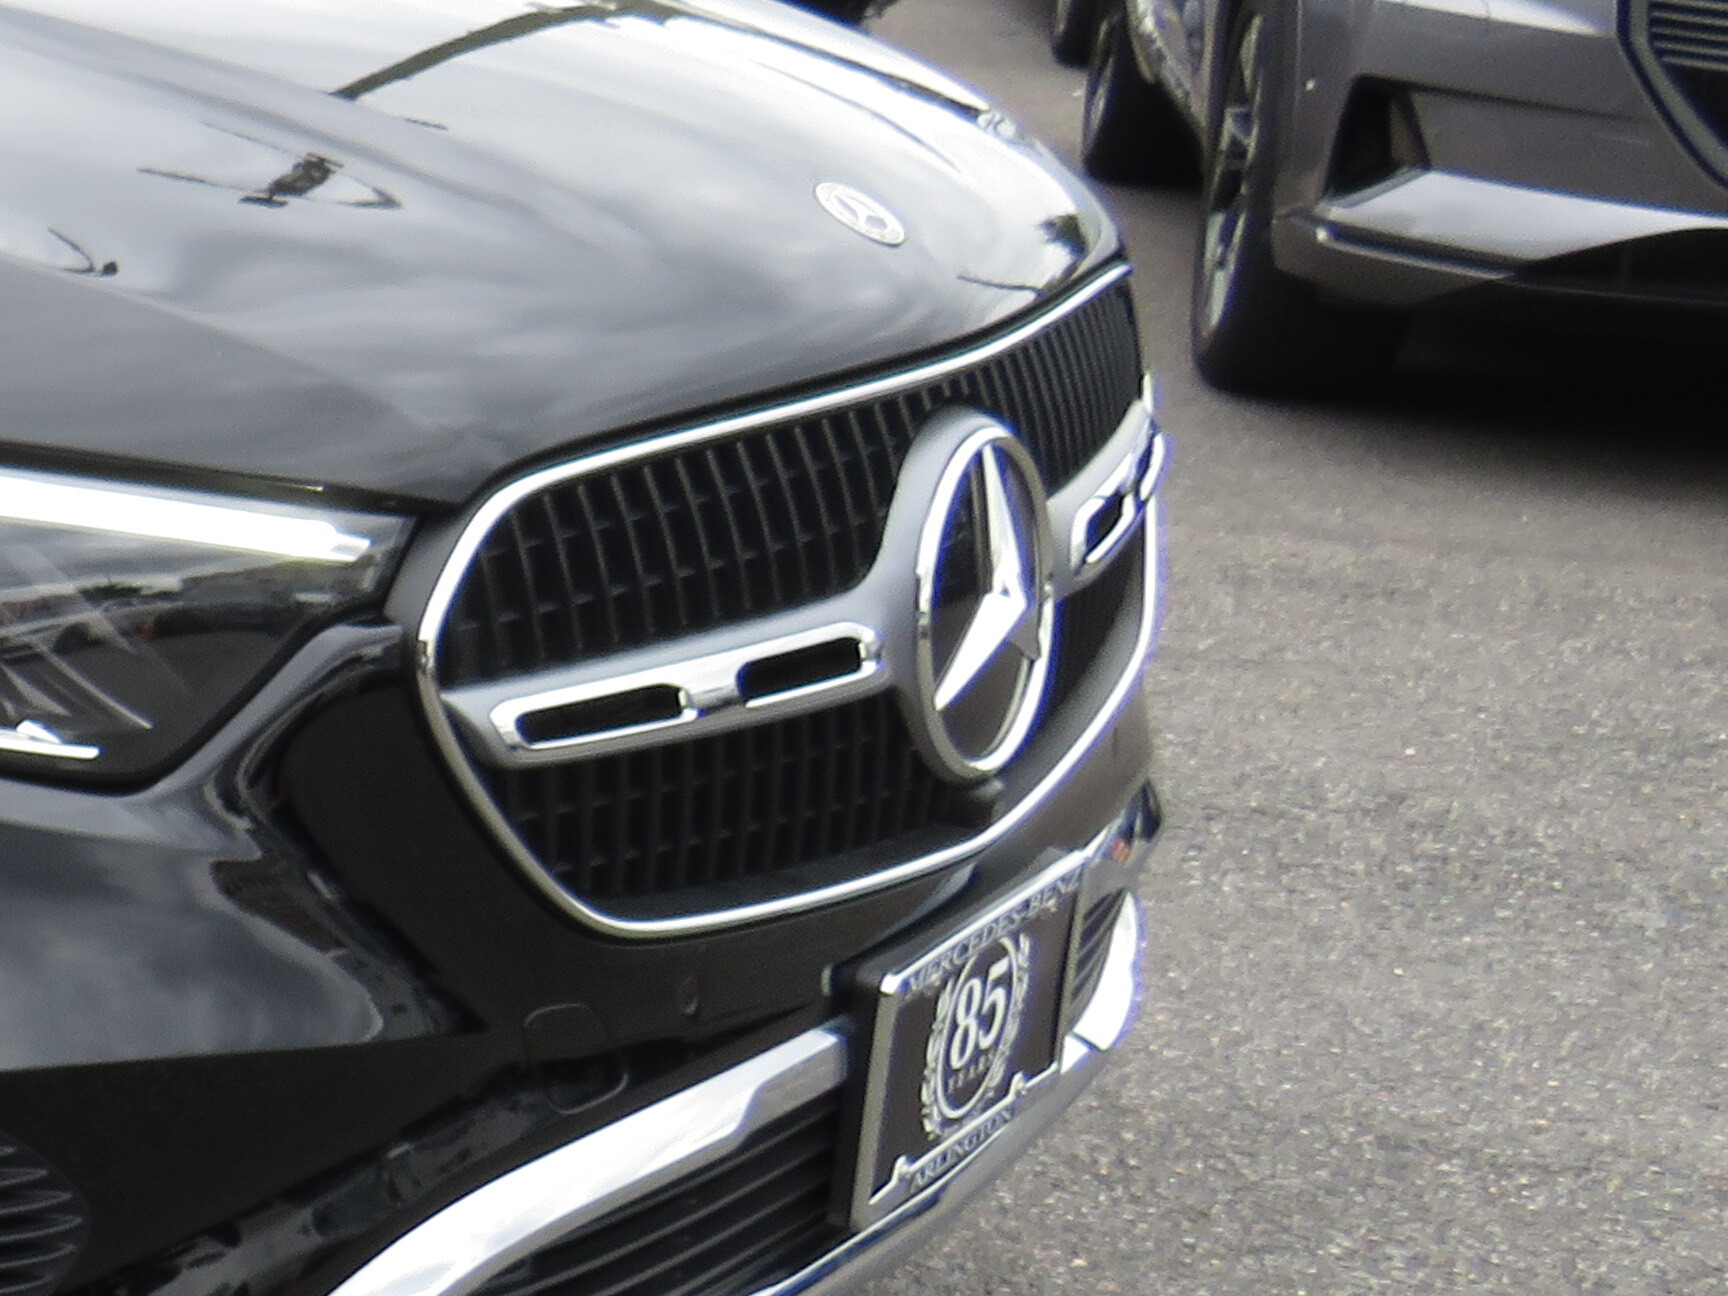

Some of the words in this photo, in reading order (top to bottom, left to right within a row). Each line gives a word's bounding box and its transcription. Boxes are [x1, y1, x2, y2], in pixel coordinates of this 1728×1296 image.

[903, 866, 1082, 996] MERCEDES-BENZ
[951, 956, 1010, 1070] 85
[909, 1107, 1014, 1192] ARLINGTON
